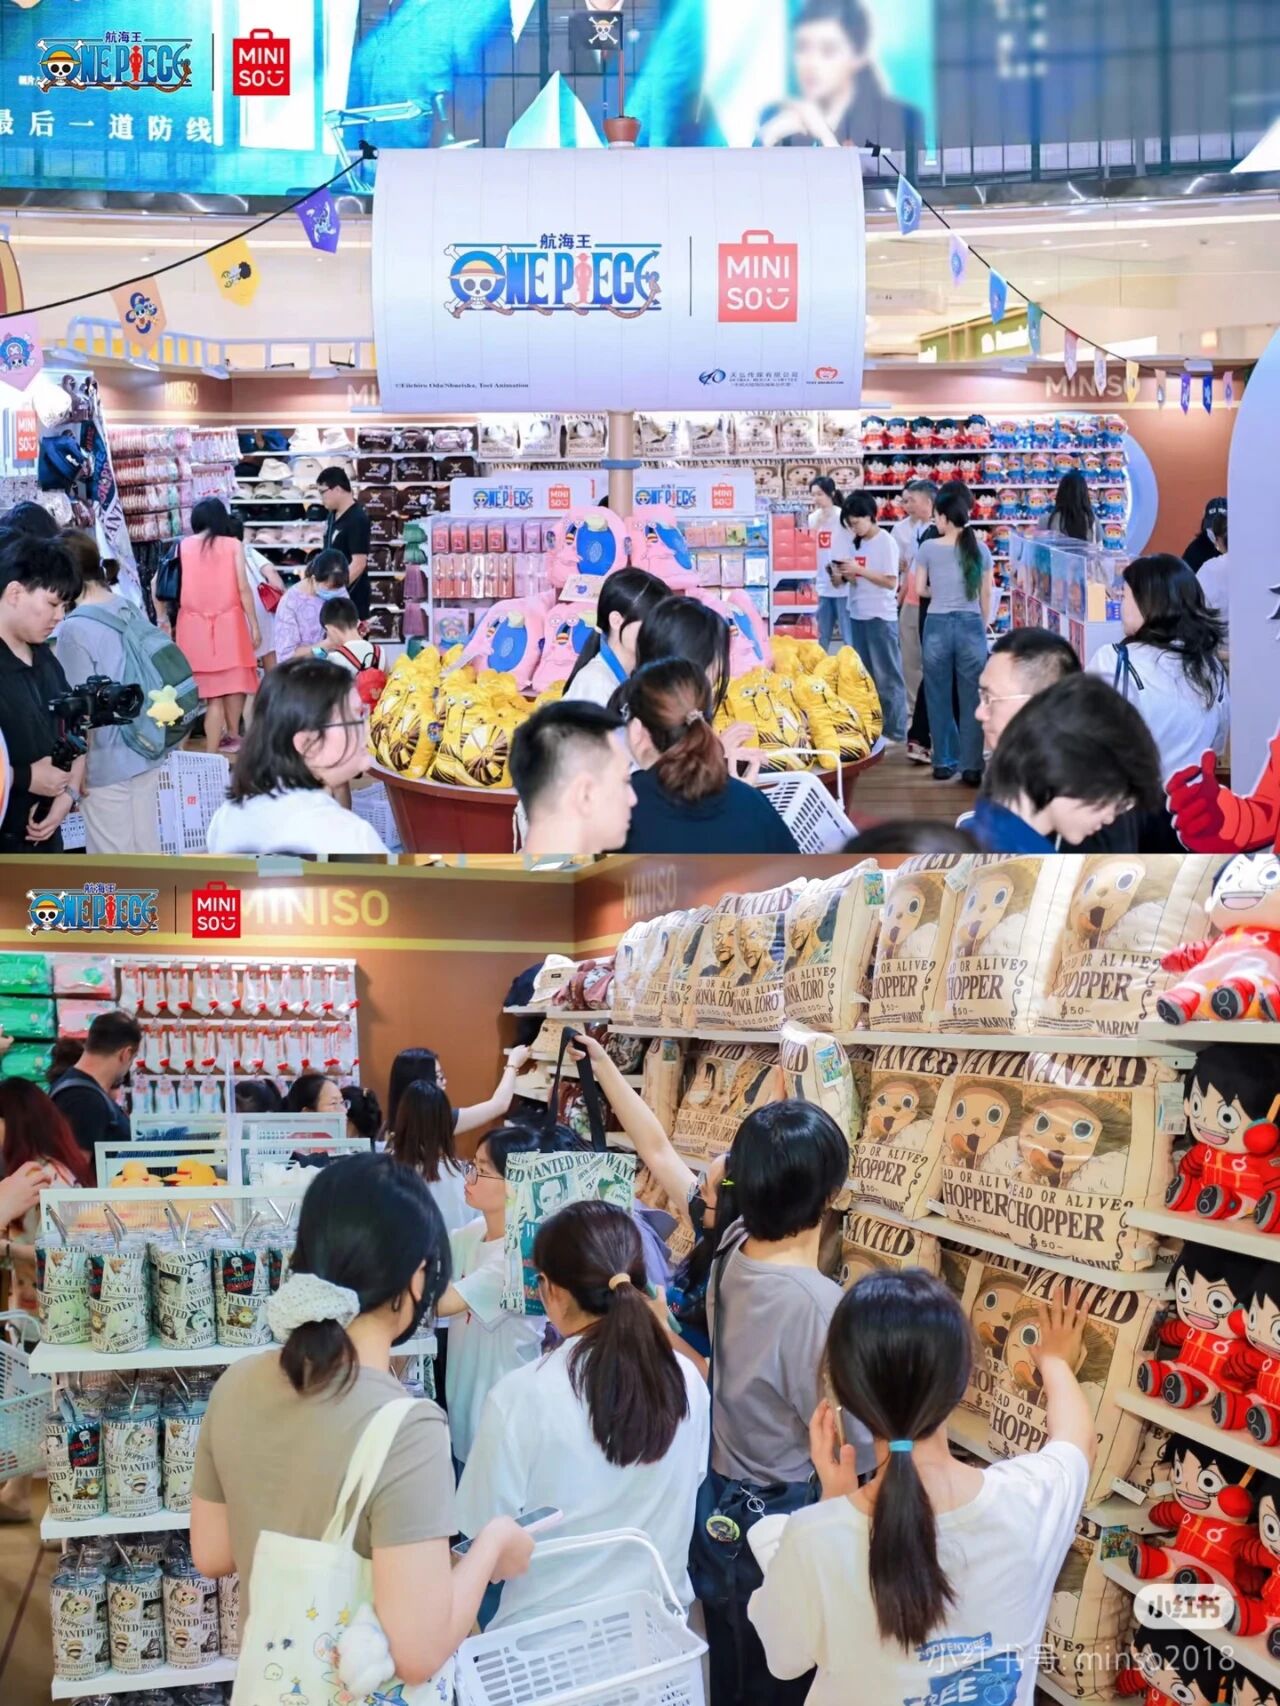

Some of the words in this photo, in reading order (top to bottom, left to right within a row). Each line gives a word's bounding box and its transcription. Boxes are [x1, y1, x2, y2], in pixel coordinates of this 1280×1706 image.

[540, 233, 592, 249] 航海王
[450, 251, 549, 305] ONE
[554, 250, 661, 305] PIECE
[726, 255, 790, 279] MINI
[549, 490, 569, 498] MINI
[881, 962, 892, 973] OR
[896, 960, 929, 972] ALIVE
[959, 961, 971, 972] OR
[976, 958, 1018, 971] ALIVE
[1080, 953, 1093, 968] OR
[1100, 952, 1149, 969] ALIVE
[800, 967, 830, 979] ALIVE
[801, 979, 824, 1001] ZORO
[872, 975, 918, 1000] HOPPER
[948, 974, 1004, 1000] HOPPER
[754, 993, 779, 1014] ZORO
[869, 1145, 881, 1158] OR
[888, 1147, 919, 1164] ALIVE
[854, 1157, 907, 1187] HOPPER
[960, 1170, 973, 1184] OR
[943, 1181, 1010, 1217] HOPPER
[1041, 1189, 1057, 1204] OR
[1065, 1195, 1122, 1212] ALIVE
[1007, 1198, 1105, 1242] CHOPPER
[1017, 1403, 1034, 1420] OR
